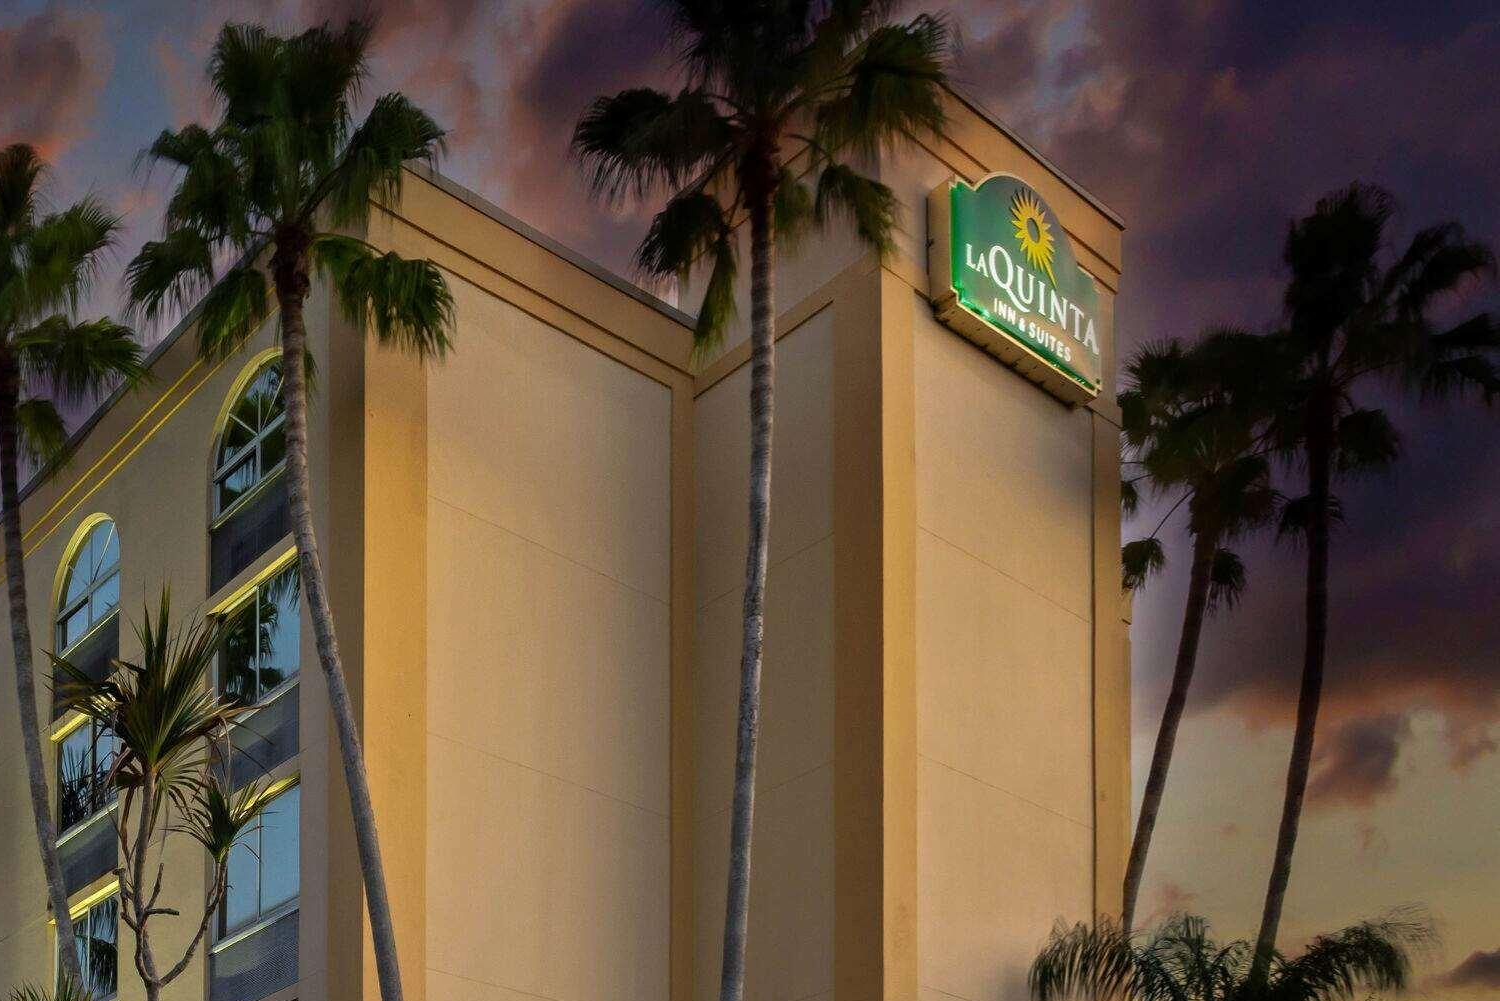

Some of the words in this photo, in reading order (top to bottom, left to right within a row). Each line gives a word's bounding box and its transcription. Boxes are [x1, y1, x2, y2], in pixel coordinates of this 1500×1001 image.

[993, 297, 1017, 326] INN
[1018, 317, 1026, 333] &
[1028, 322, 1071, 362] SUITES
